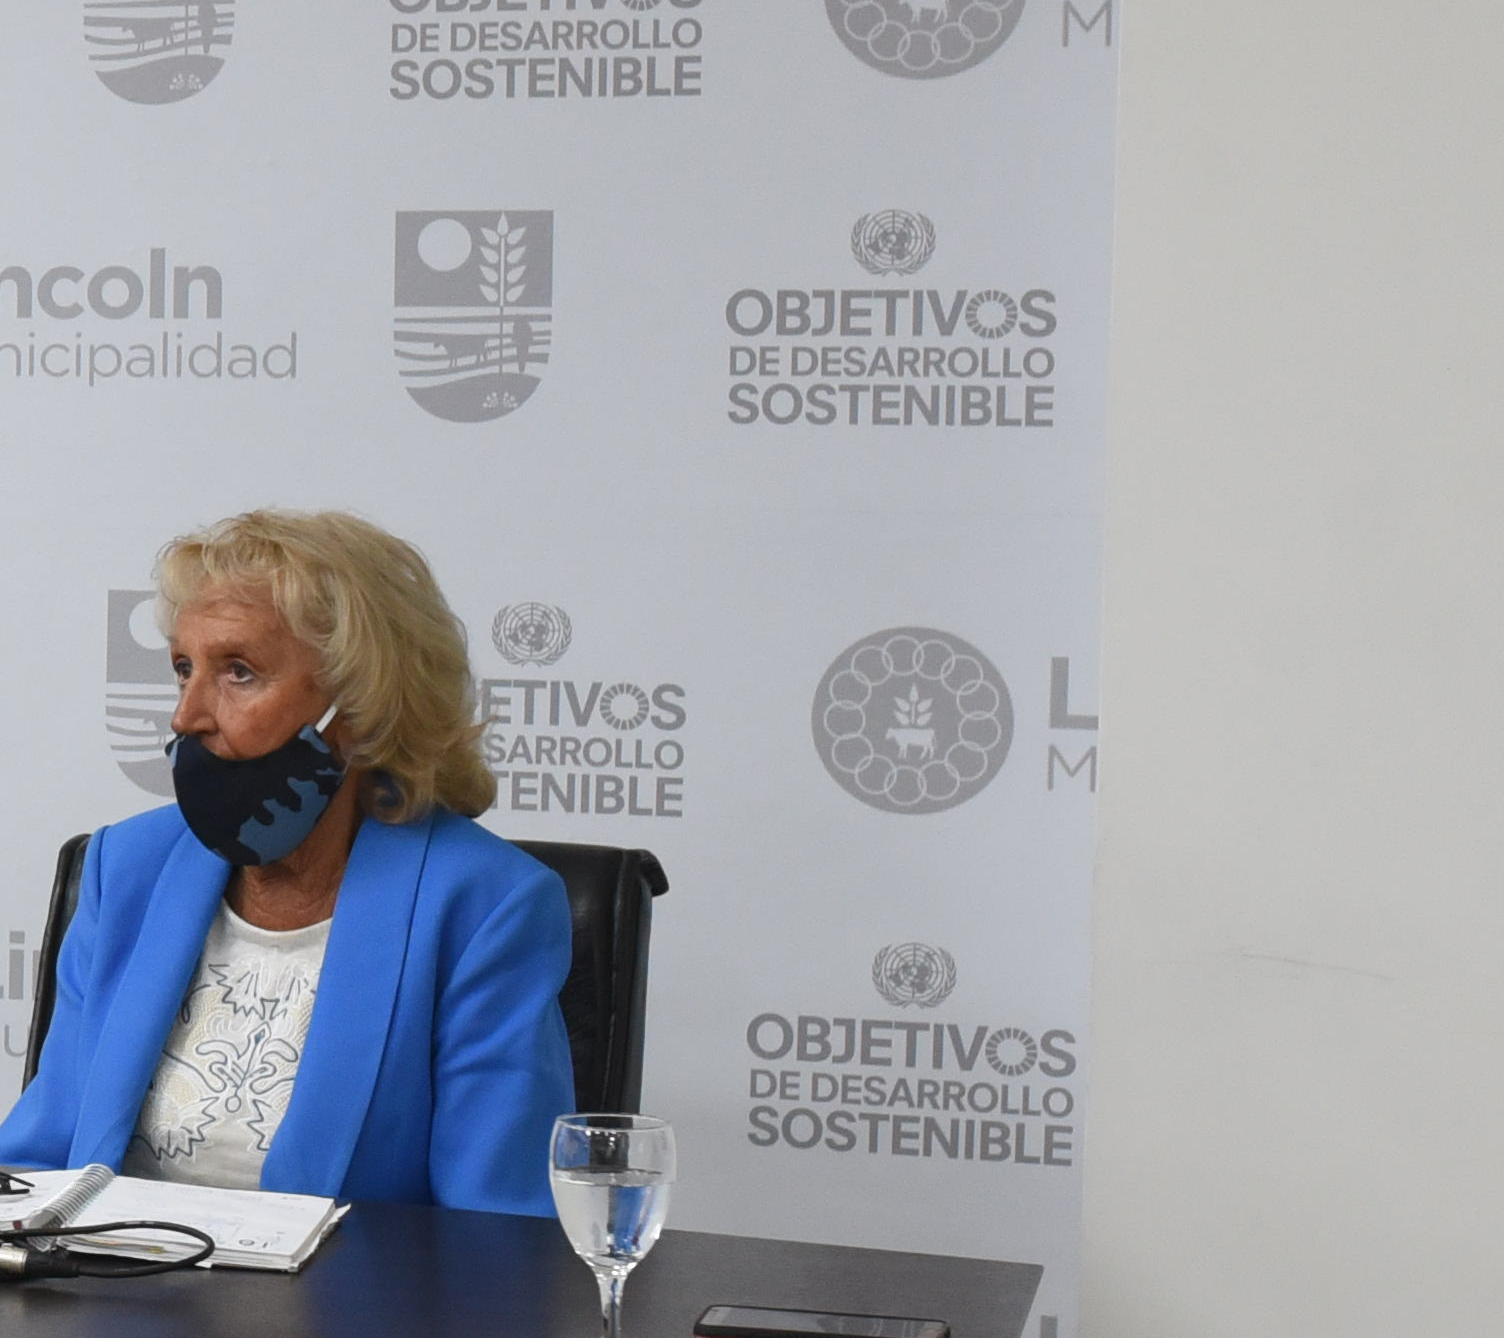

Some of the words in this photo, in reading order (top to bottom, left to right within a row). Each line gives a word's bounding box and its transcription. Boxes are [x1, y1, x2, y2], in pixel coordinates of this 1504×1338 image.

[392, 23, 439, 53] DE
[451, 18, 702, 52] DESARROLLO
[390, 55, 702, 99] SOSTENIBLE
[726, 289, 1056, 339] OBJETIVOS
[730, 346, 780, 376] DE
[791, 347, 1054, 378] DESARROLLO
[728, 383, 1054, 427] SOSTENIBLE
[747, 1013, 1076, 1078] OBJETIVOS
[750, 1069, 800, 1101] DE
[811, 1066, 1073, 1118] DESARROLLO
[748, 1106, 1073, 1166] SOSTENIBLE
